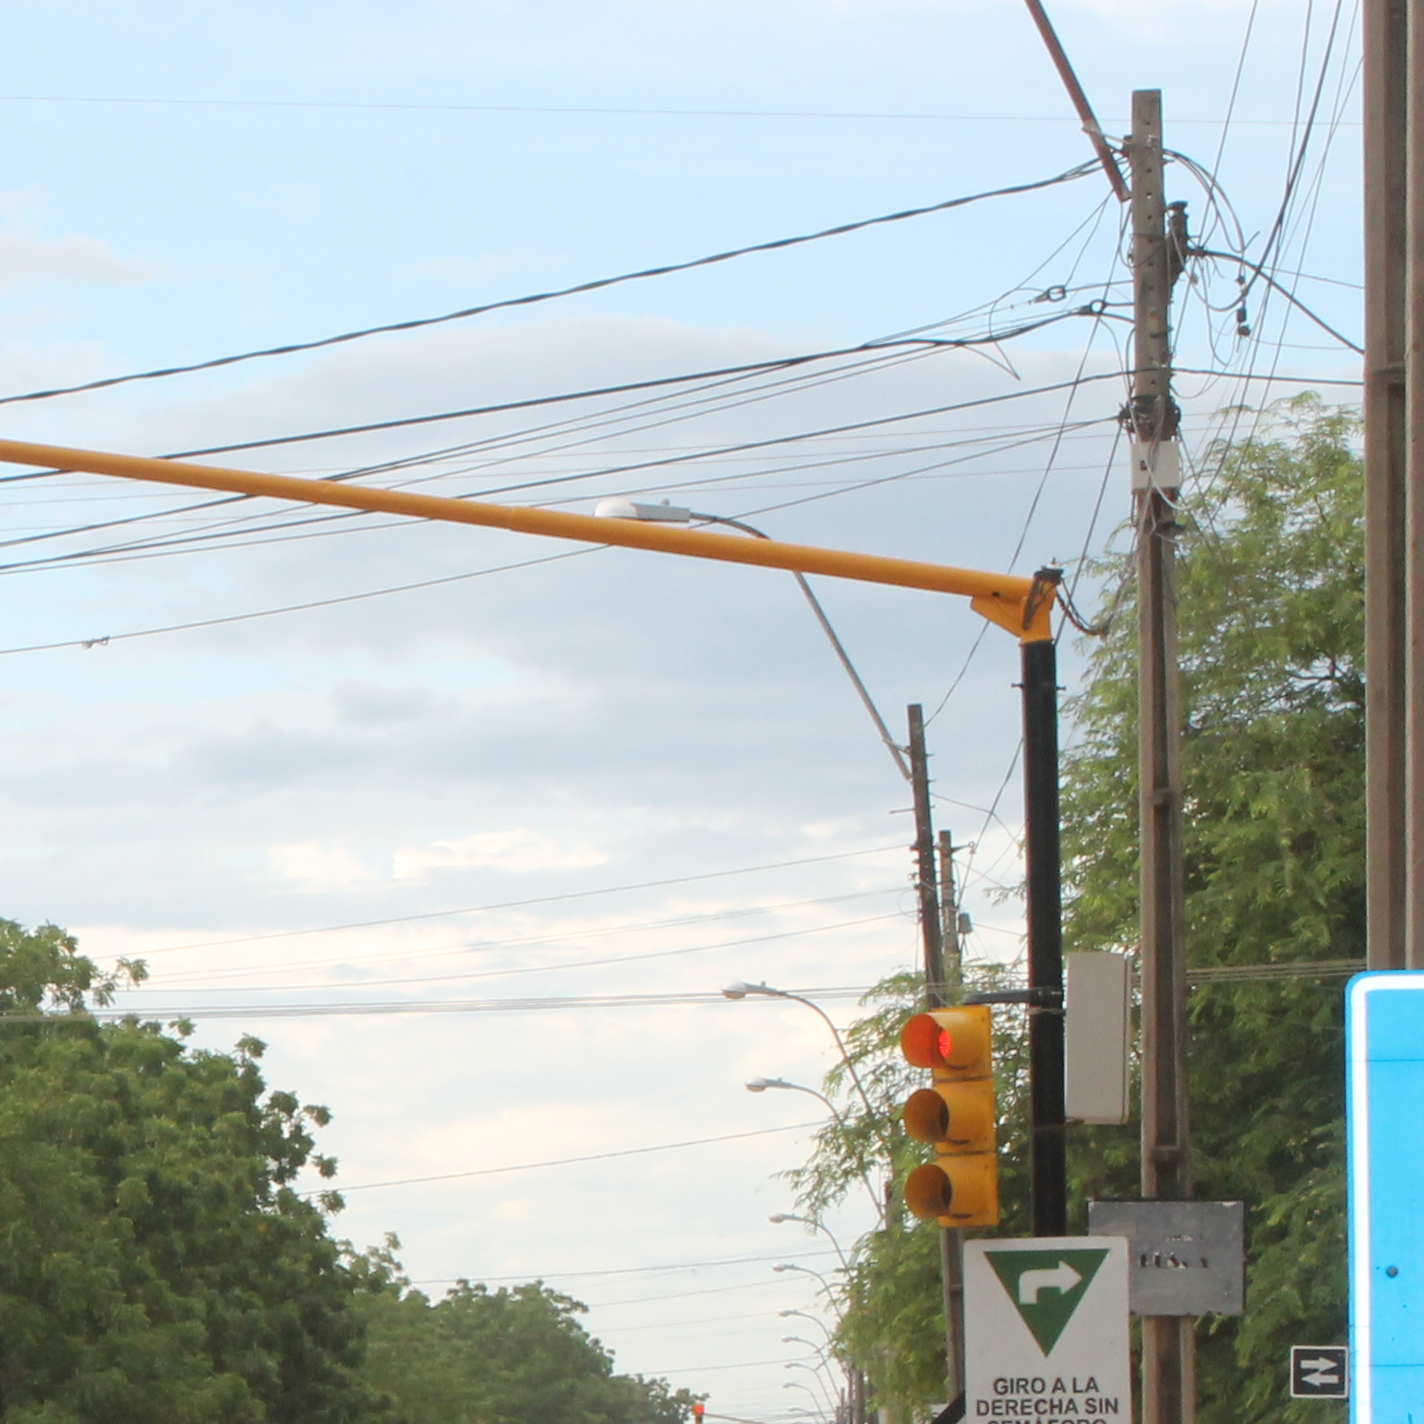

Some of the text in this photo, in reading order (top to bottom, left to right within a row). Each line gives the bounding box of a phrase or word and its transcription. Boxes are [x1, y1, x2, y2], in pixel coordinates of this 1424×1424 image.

[993, 1376, 1099, 1395] GIRO A LA
[976, 1397, 1118, 1416] DERECHA SIN
